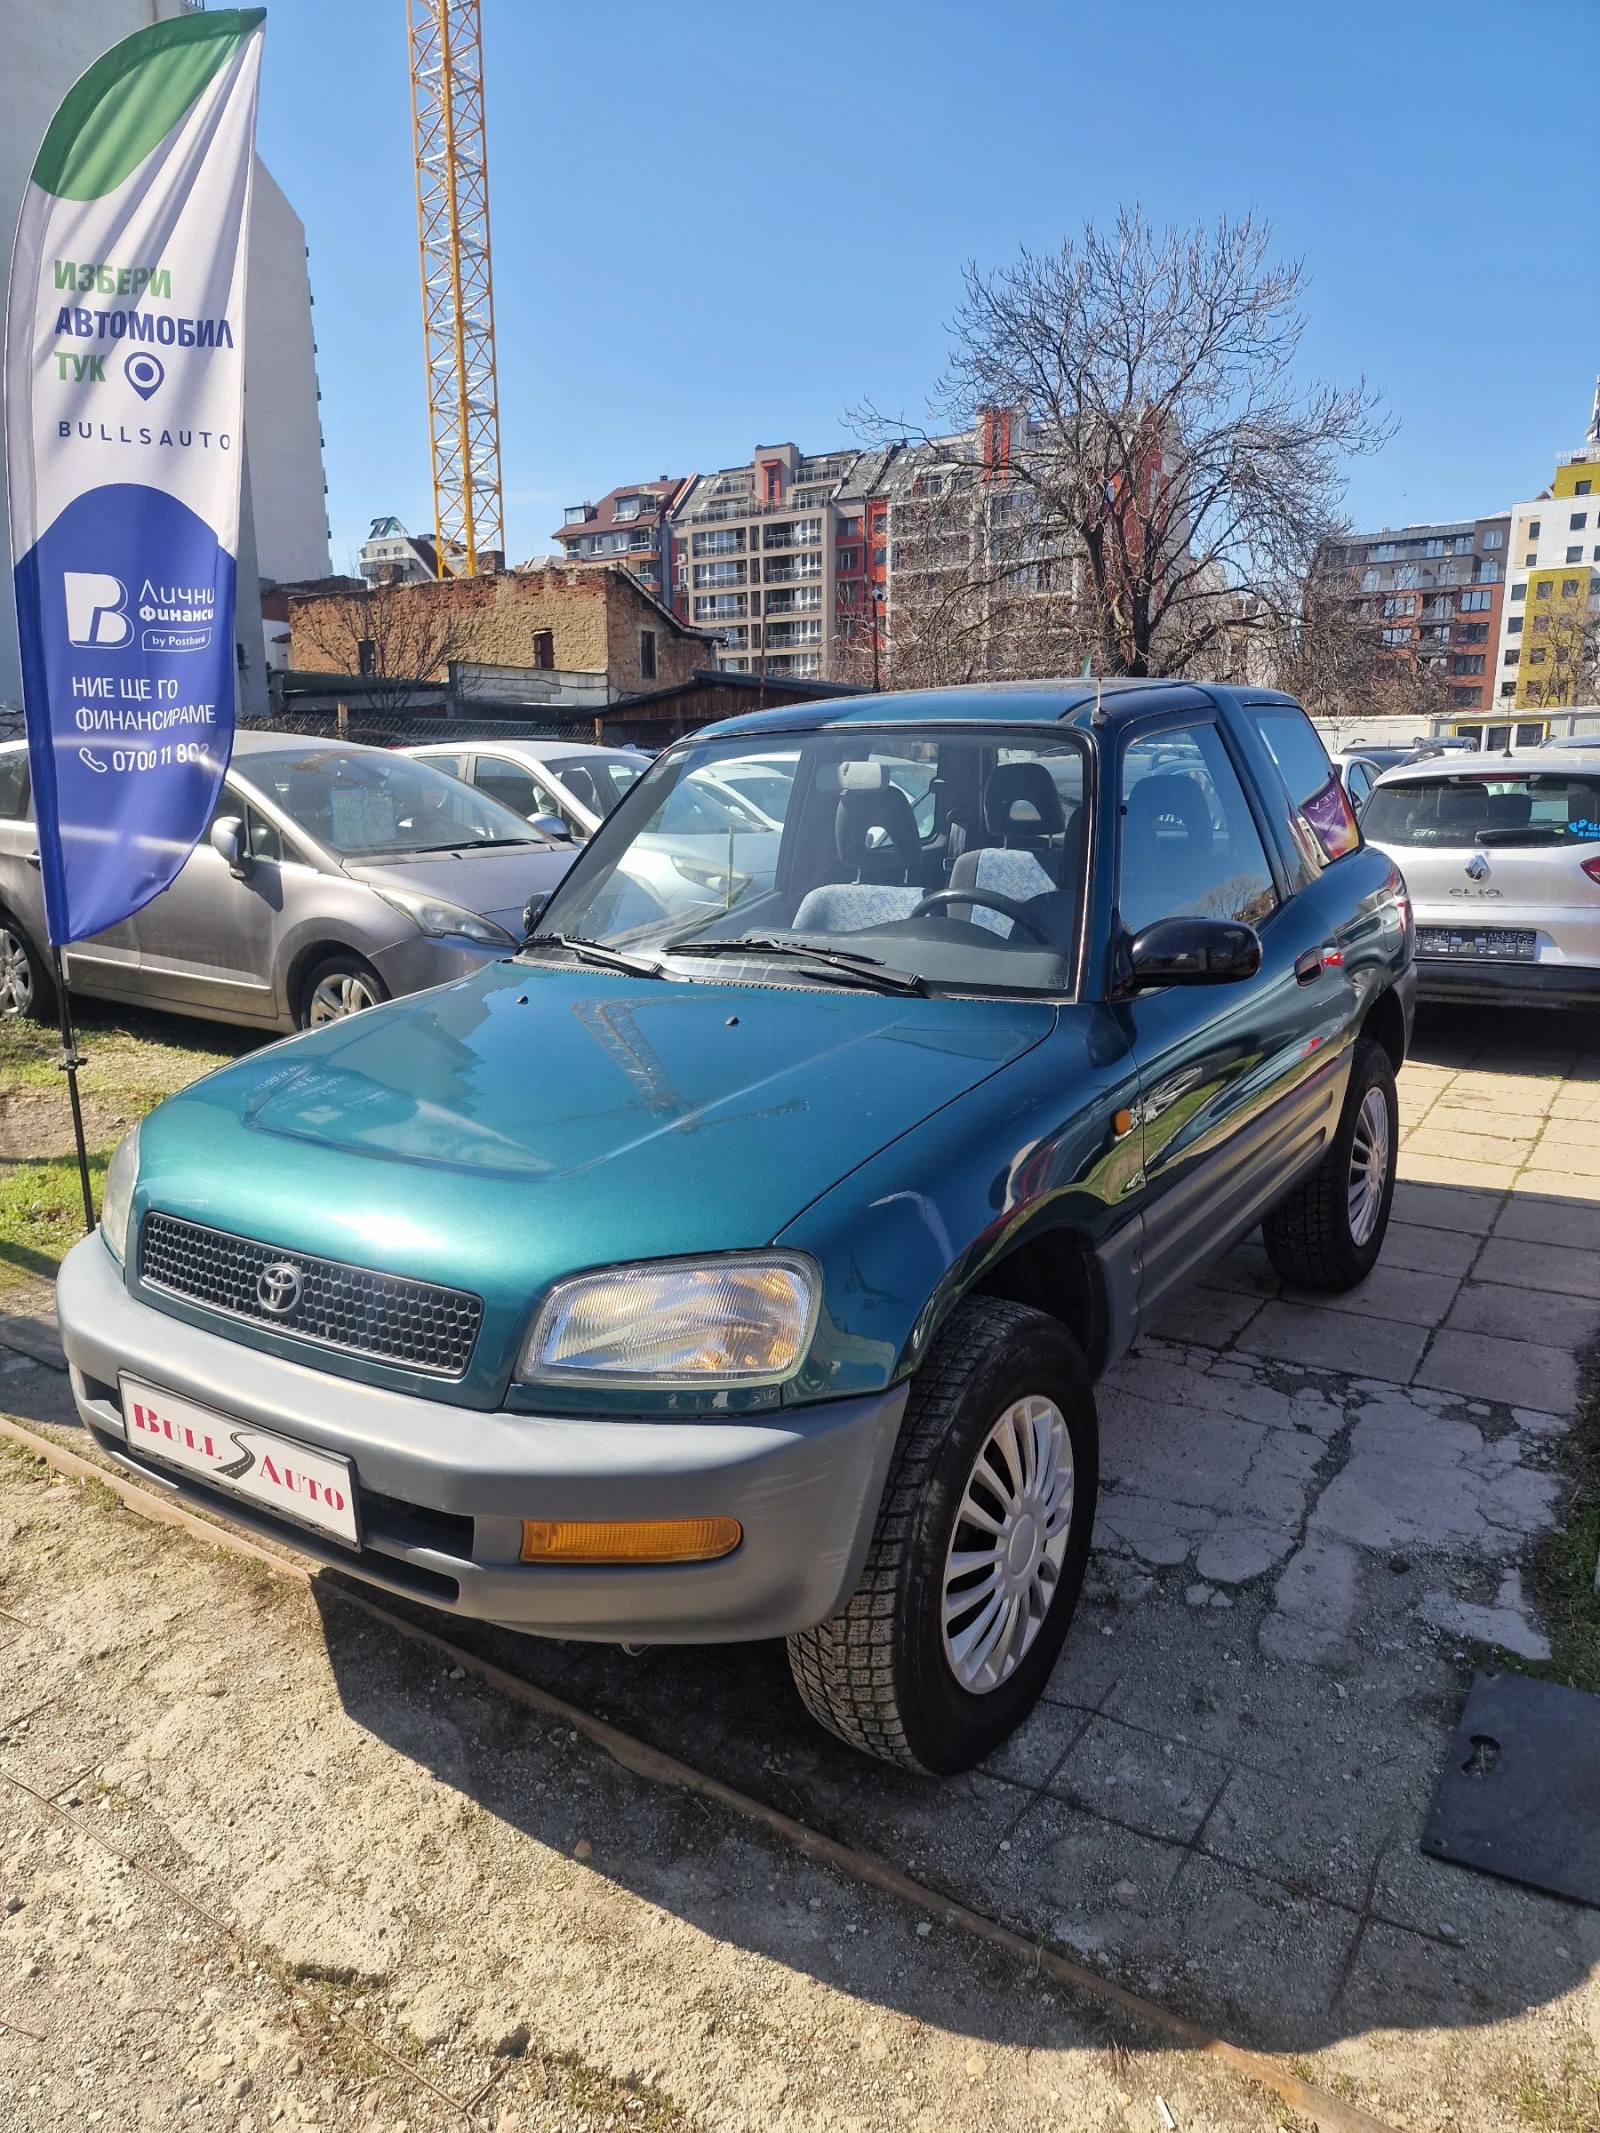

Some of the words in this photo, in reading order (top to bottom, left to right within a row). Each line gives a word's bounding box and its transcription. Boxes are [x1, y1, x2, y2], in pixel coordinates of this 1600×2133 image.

[54, 260, 171, 299] ИЗБЕРИ
[55, 307, 234, 349] АВТОМОБИЛ
[54, 351, 107, 382] ТУК
[58, 421, 231, 450] BULLSAUTO
[139, 579, 215, 605] Лични
[139, 605, 214, 622] Финанси
[152, 635, 165, 648] by
[168, 634, 206, 646] Postbank
[72, 676, 115, 698] НИЕ
[120, 678, 152, 701] ЩЕ
[158, 680, 179, 699] ГО
[75, 704, 217, 732] ФИНАНСИРАМЕ
[112, 749, 157, 772] 0700
[160, 745, 172, 765] 11
[1449, 888, 1500, 897] CLIO
